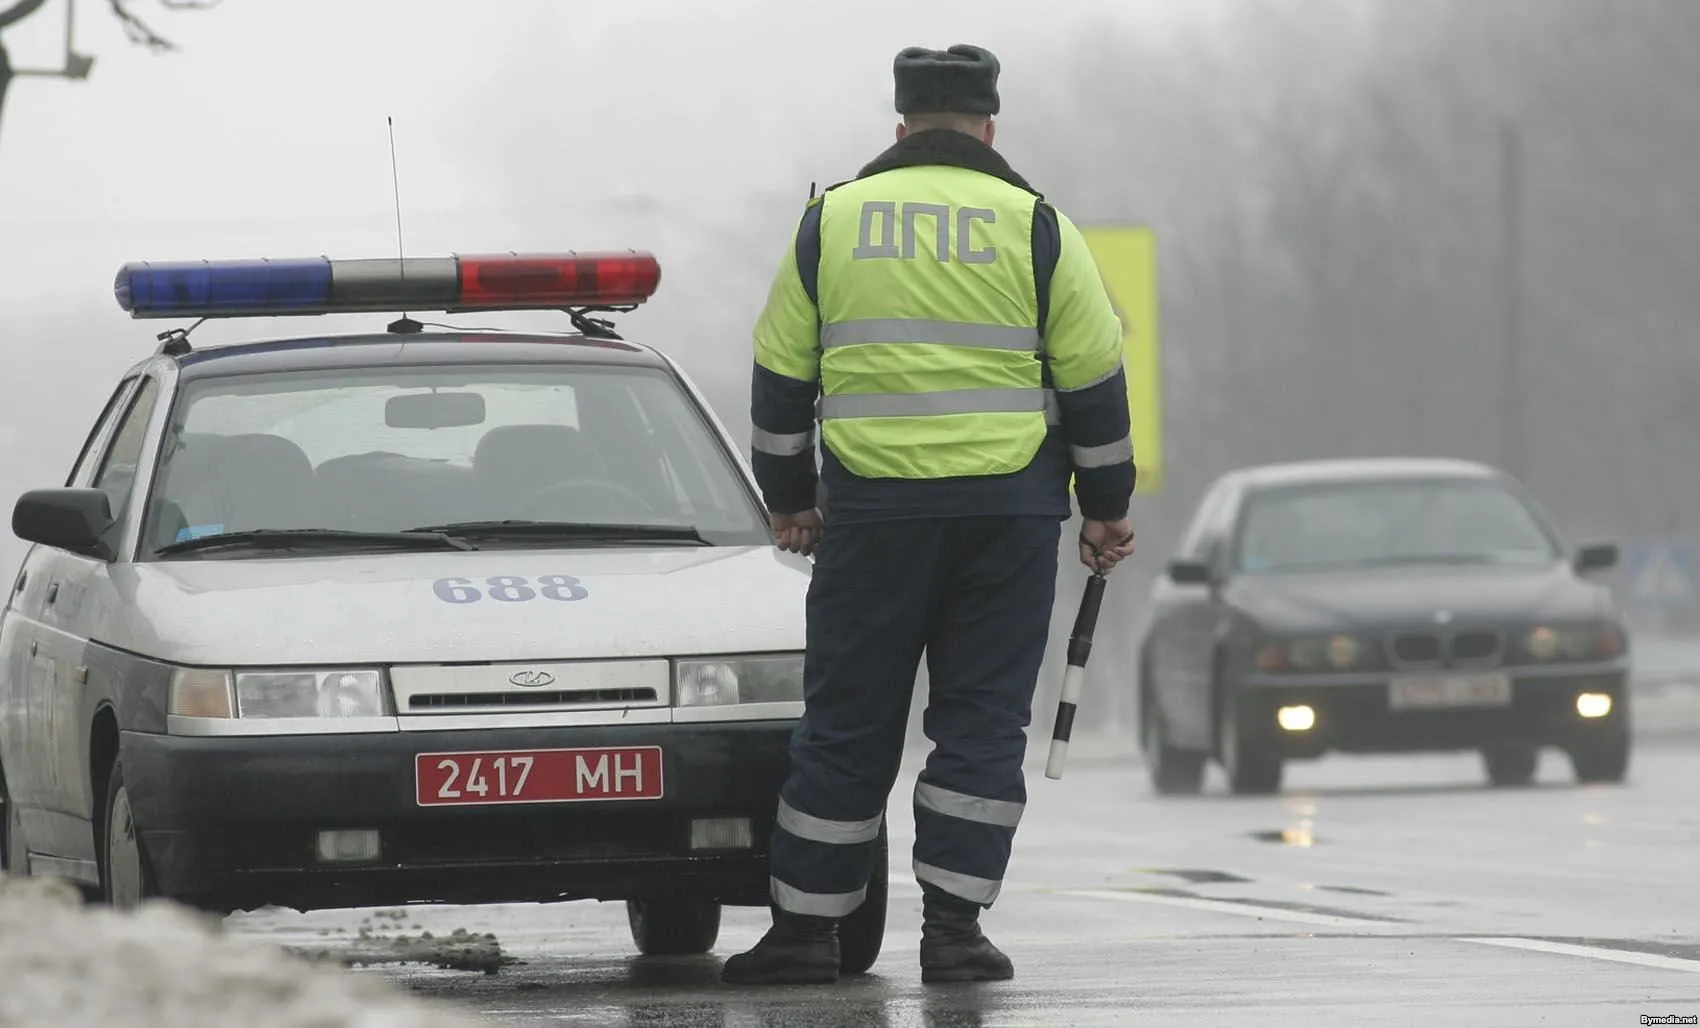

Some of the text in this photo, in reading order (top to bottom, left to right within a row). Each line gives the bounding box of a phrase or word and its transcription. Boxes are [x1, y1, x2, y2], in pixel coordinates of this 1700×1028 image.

[852, 201, 996, 264] ДПС
[433, 575, 589, 604] 688
[437, 757, 534, 797] 2417
